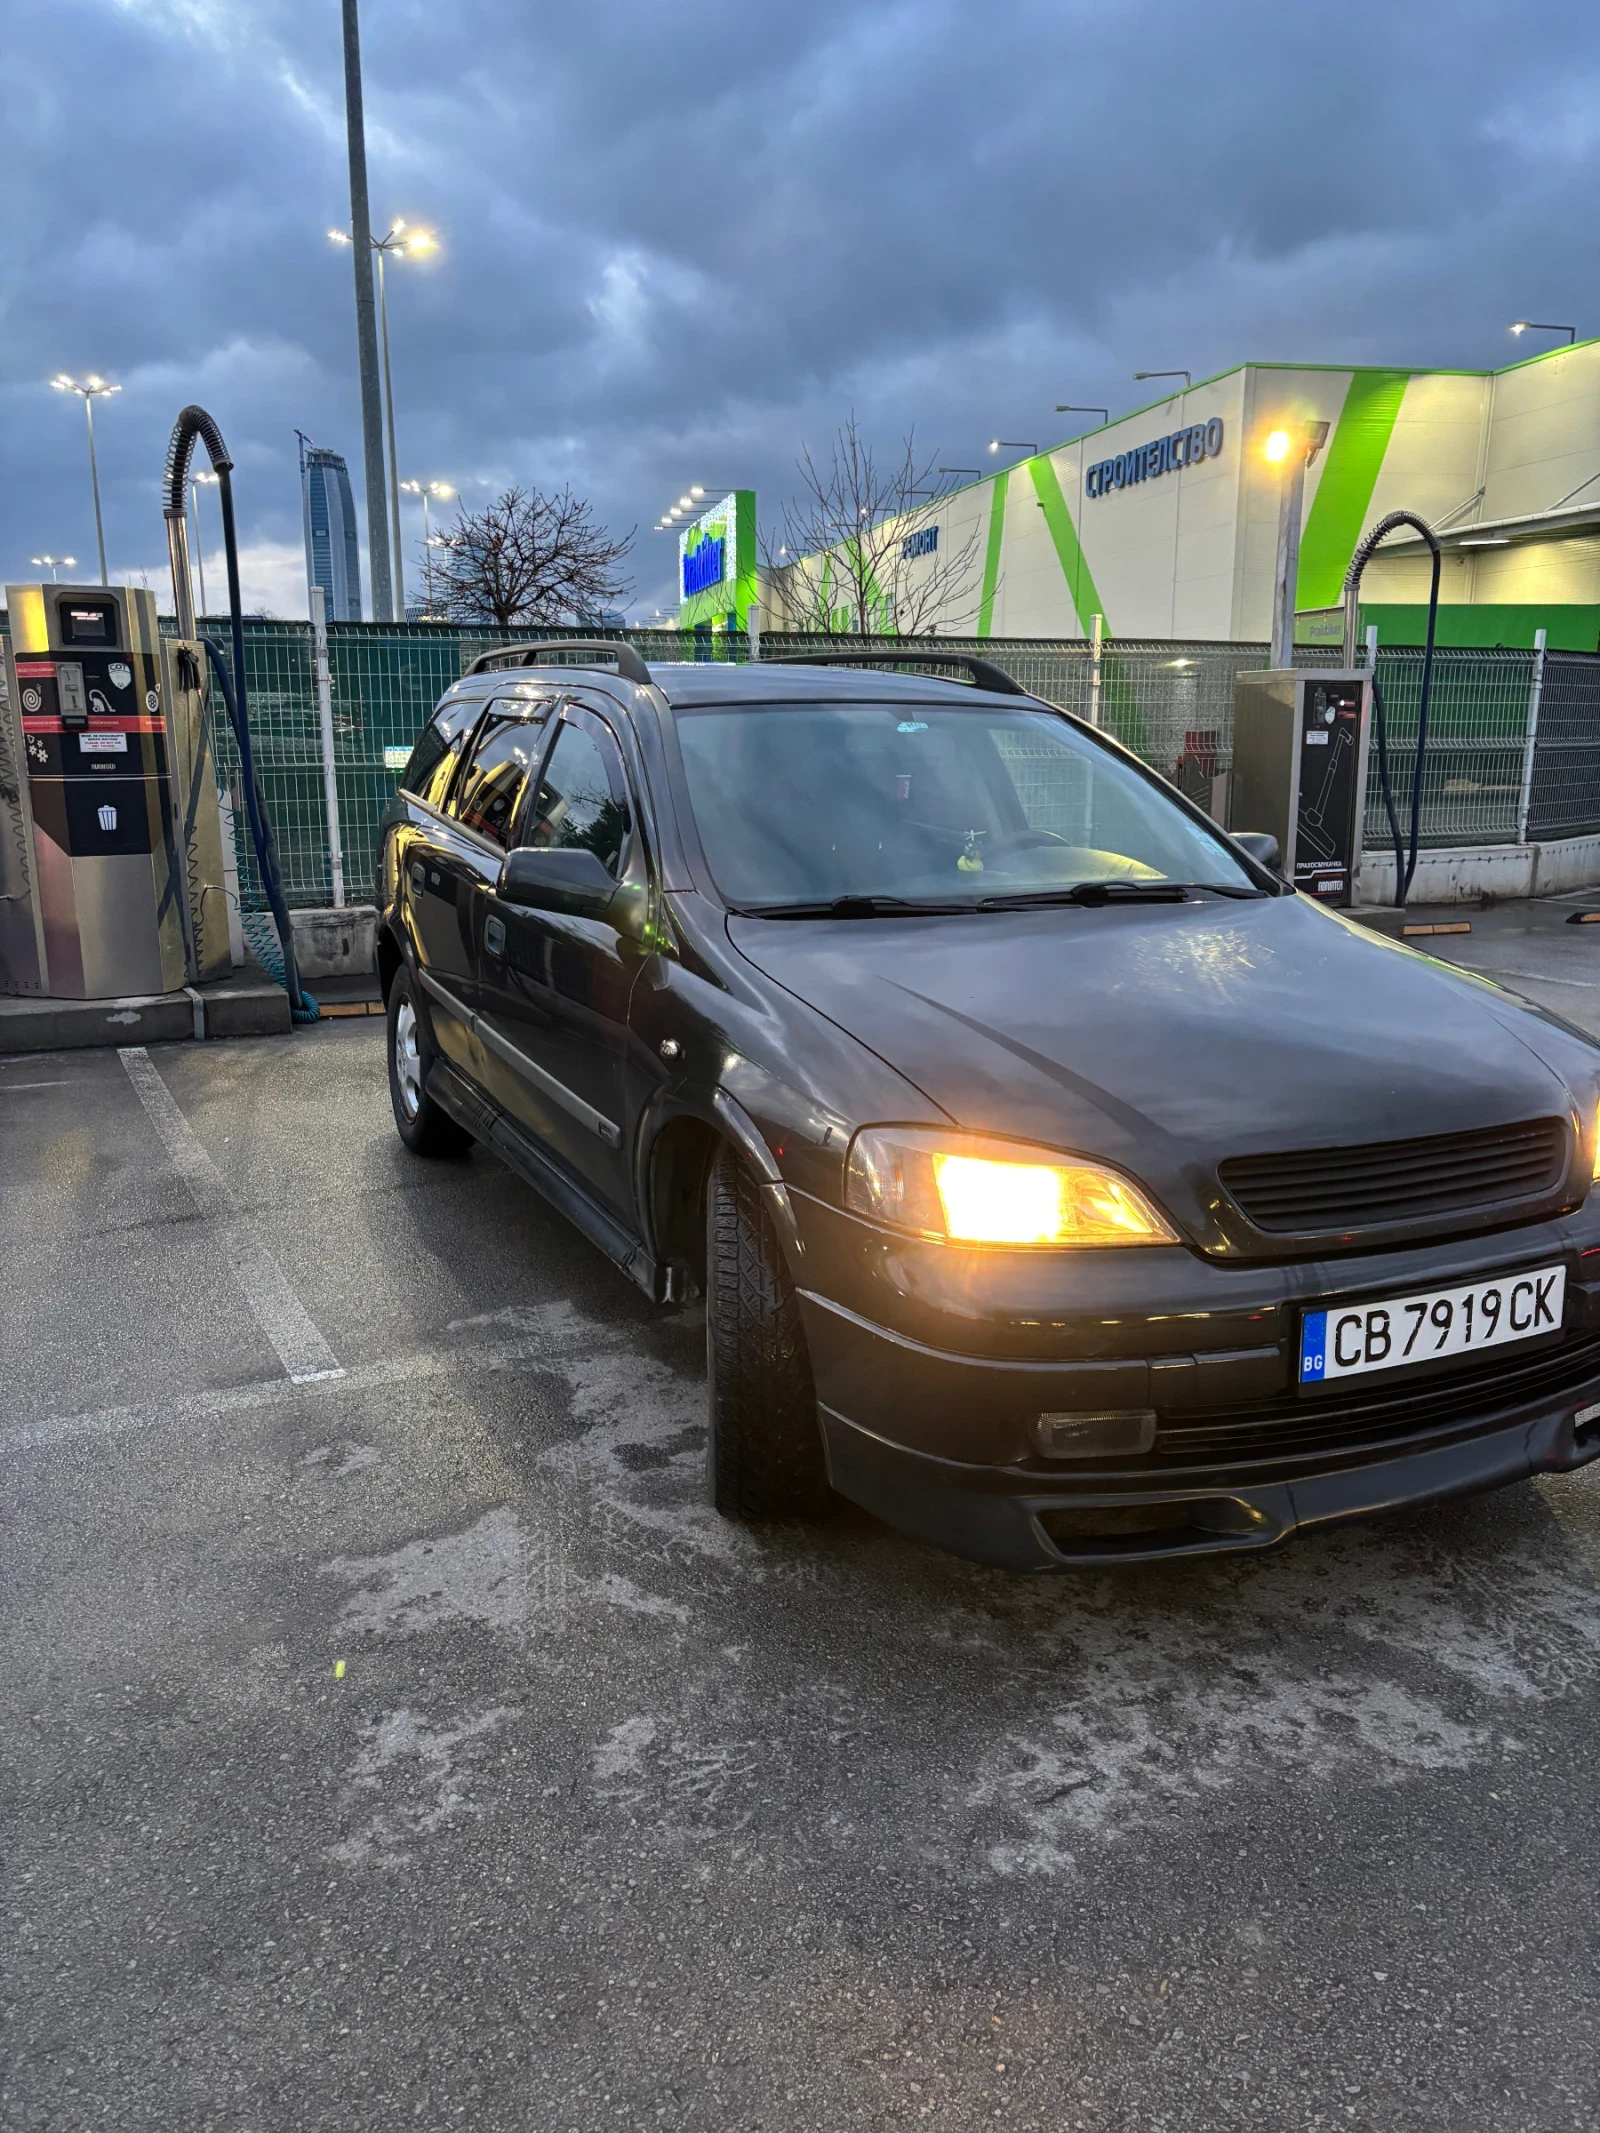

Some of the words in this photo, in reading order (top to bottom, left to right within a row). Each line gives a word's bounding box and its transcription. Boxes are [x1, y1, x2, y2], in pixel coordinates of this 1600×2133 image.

[1085, 417, 1224, 498] СТРОИТЕЛСТВО
[1296, 861, 1342, 869] ПРАХОСМУКАЧКА
[1304, 1354, 1323, 1372] BG
